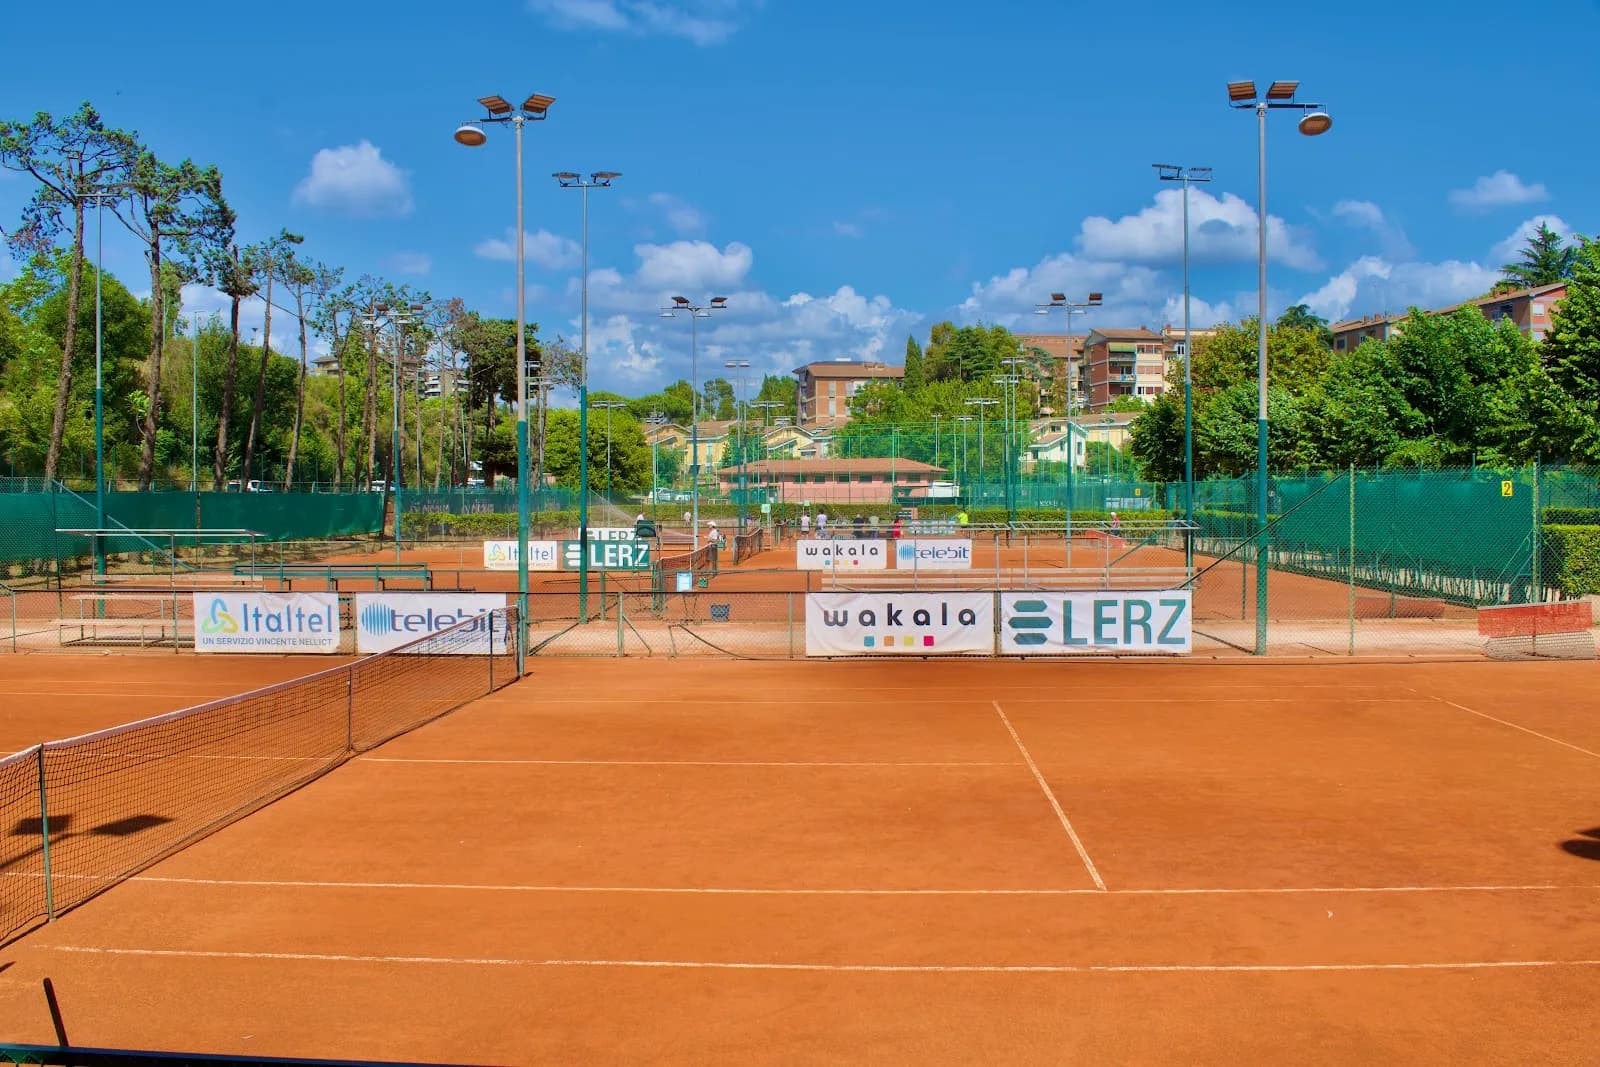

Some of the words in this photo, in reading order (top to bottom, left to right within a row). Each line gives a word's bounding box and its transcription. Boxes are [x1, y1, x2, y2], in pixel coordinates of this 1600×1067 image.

[1503, 482, 1511, 496] 2
[508, 545, 553, 560] Itltel
[805, 544, 878, 556] wakala
[243, 603, 332, 632] Italtel
[823, 602, 976, 627] wakala
[202, 637, 214, 645] UN
[216, 637, 254, 645] SERVIZIO
[255, 637, 297, 646] VINCENTE
